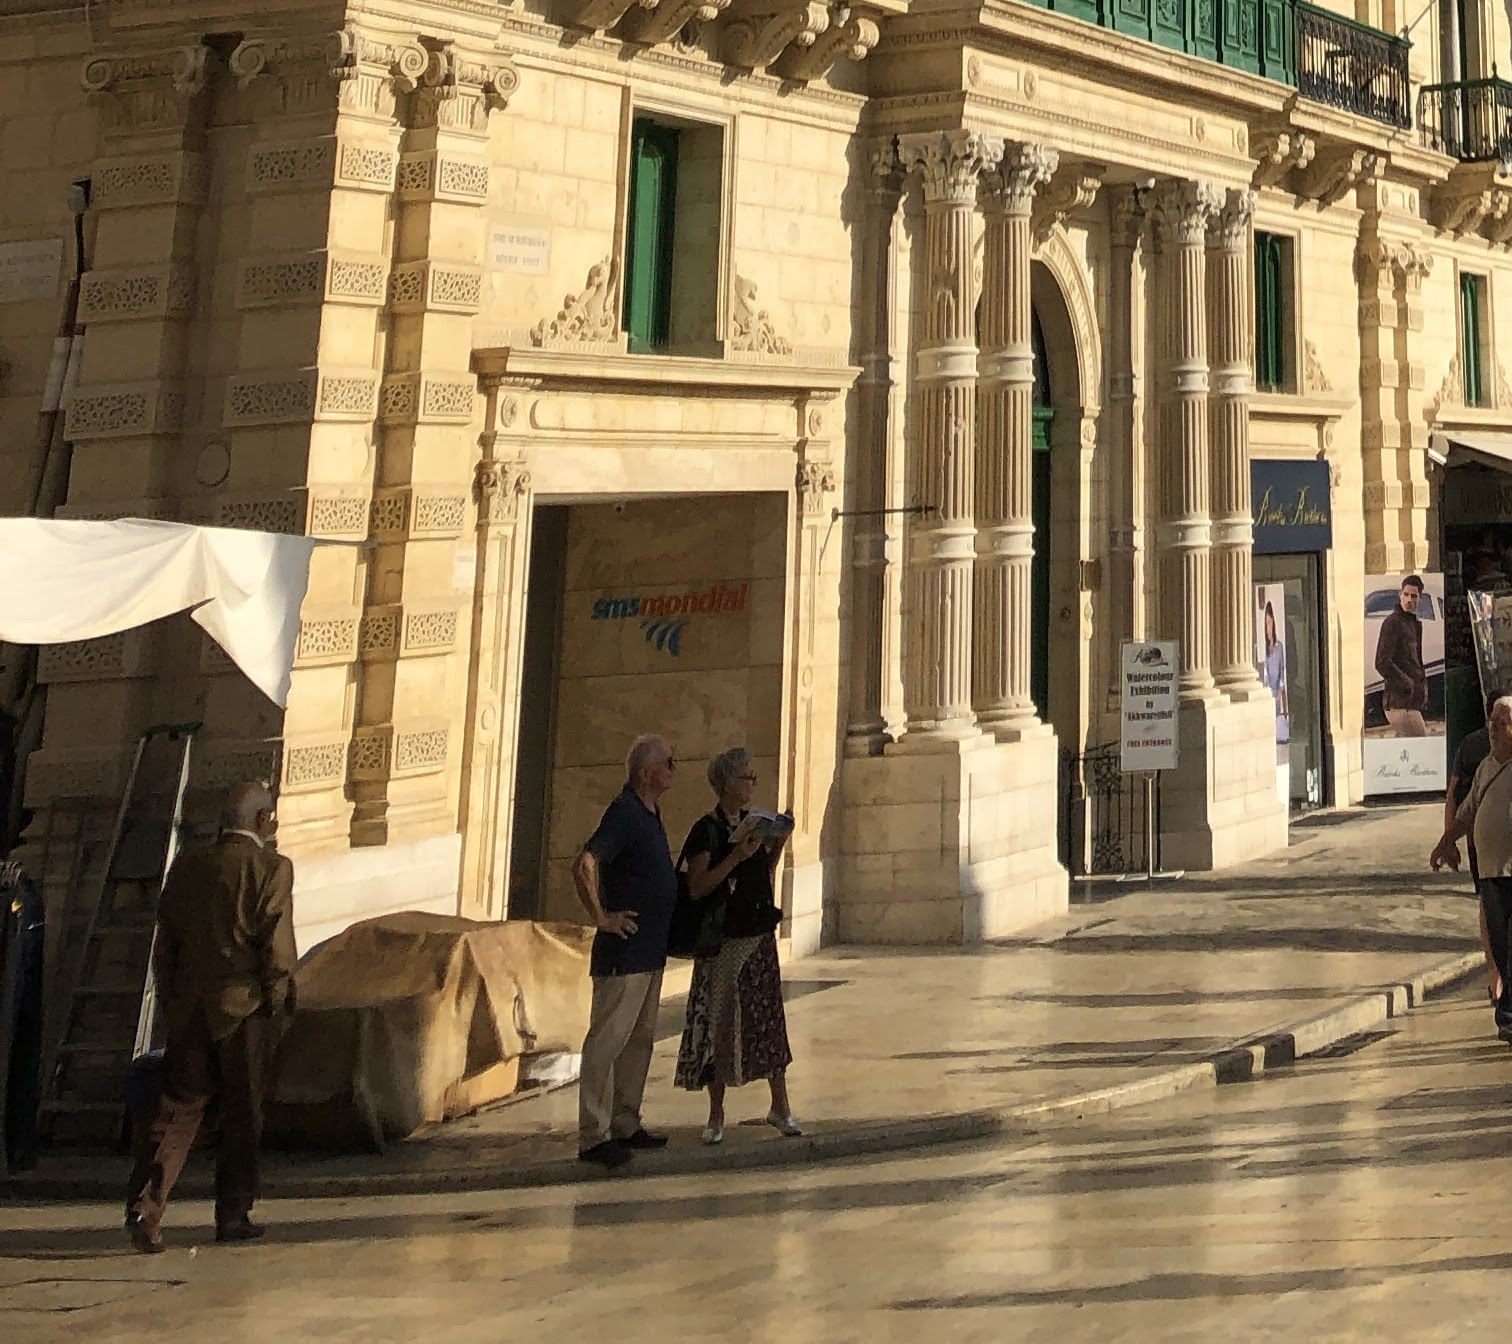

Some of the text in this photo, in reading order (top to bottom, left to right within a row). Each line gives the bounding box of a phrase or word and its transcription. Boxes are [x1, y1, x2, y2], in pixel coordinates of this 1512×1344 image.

[1126, 672, 1174, 683] Watercolour
[1130, 685, 1170, 697] Exhibition
[1127, 738, 1172, 748] FREE ENTRANCE
